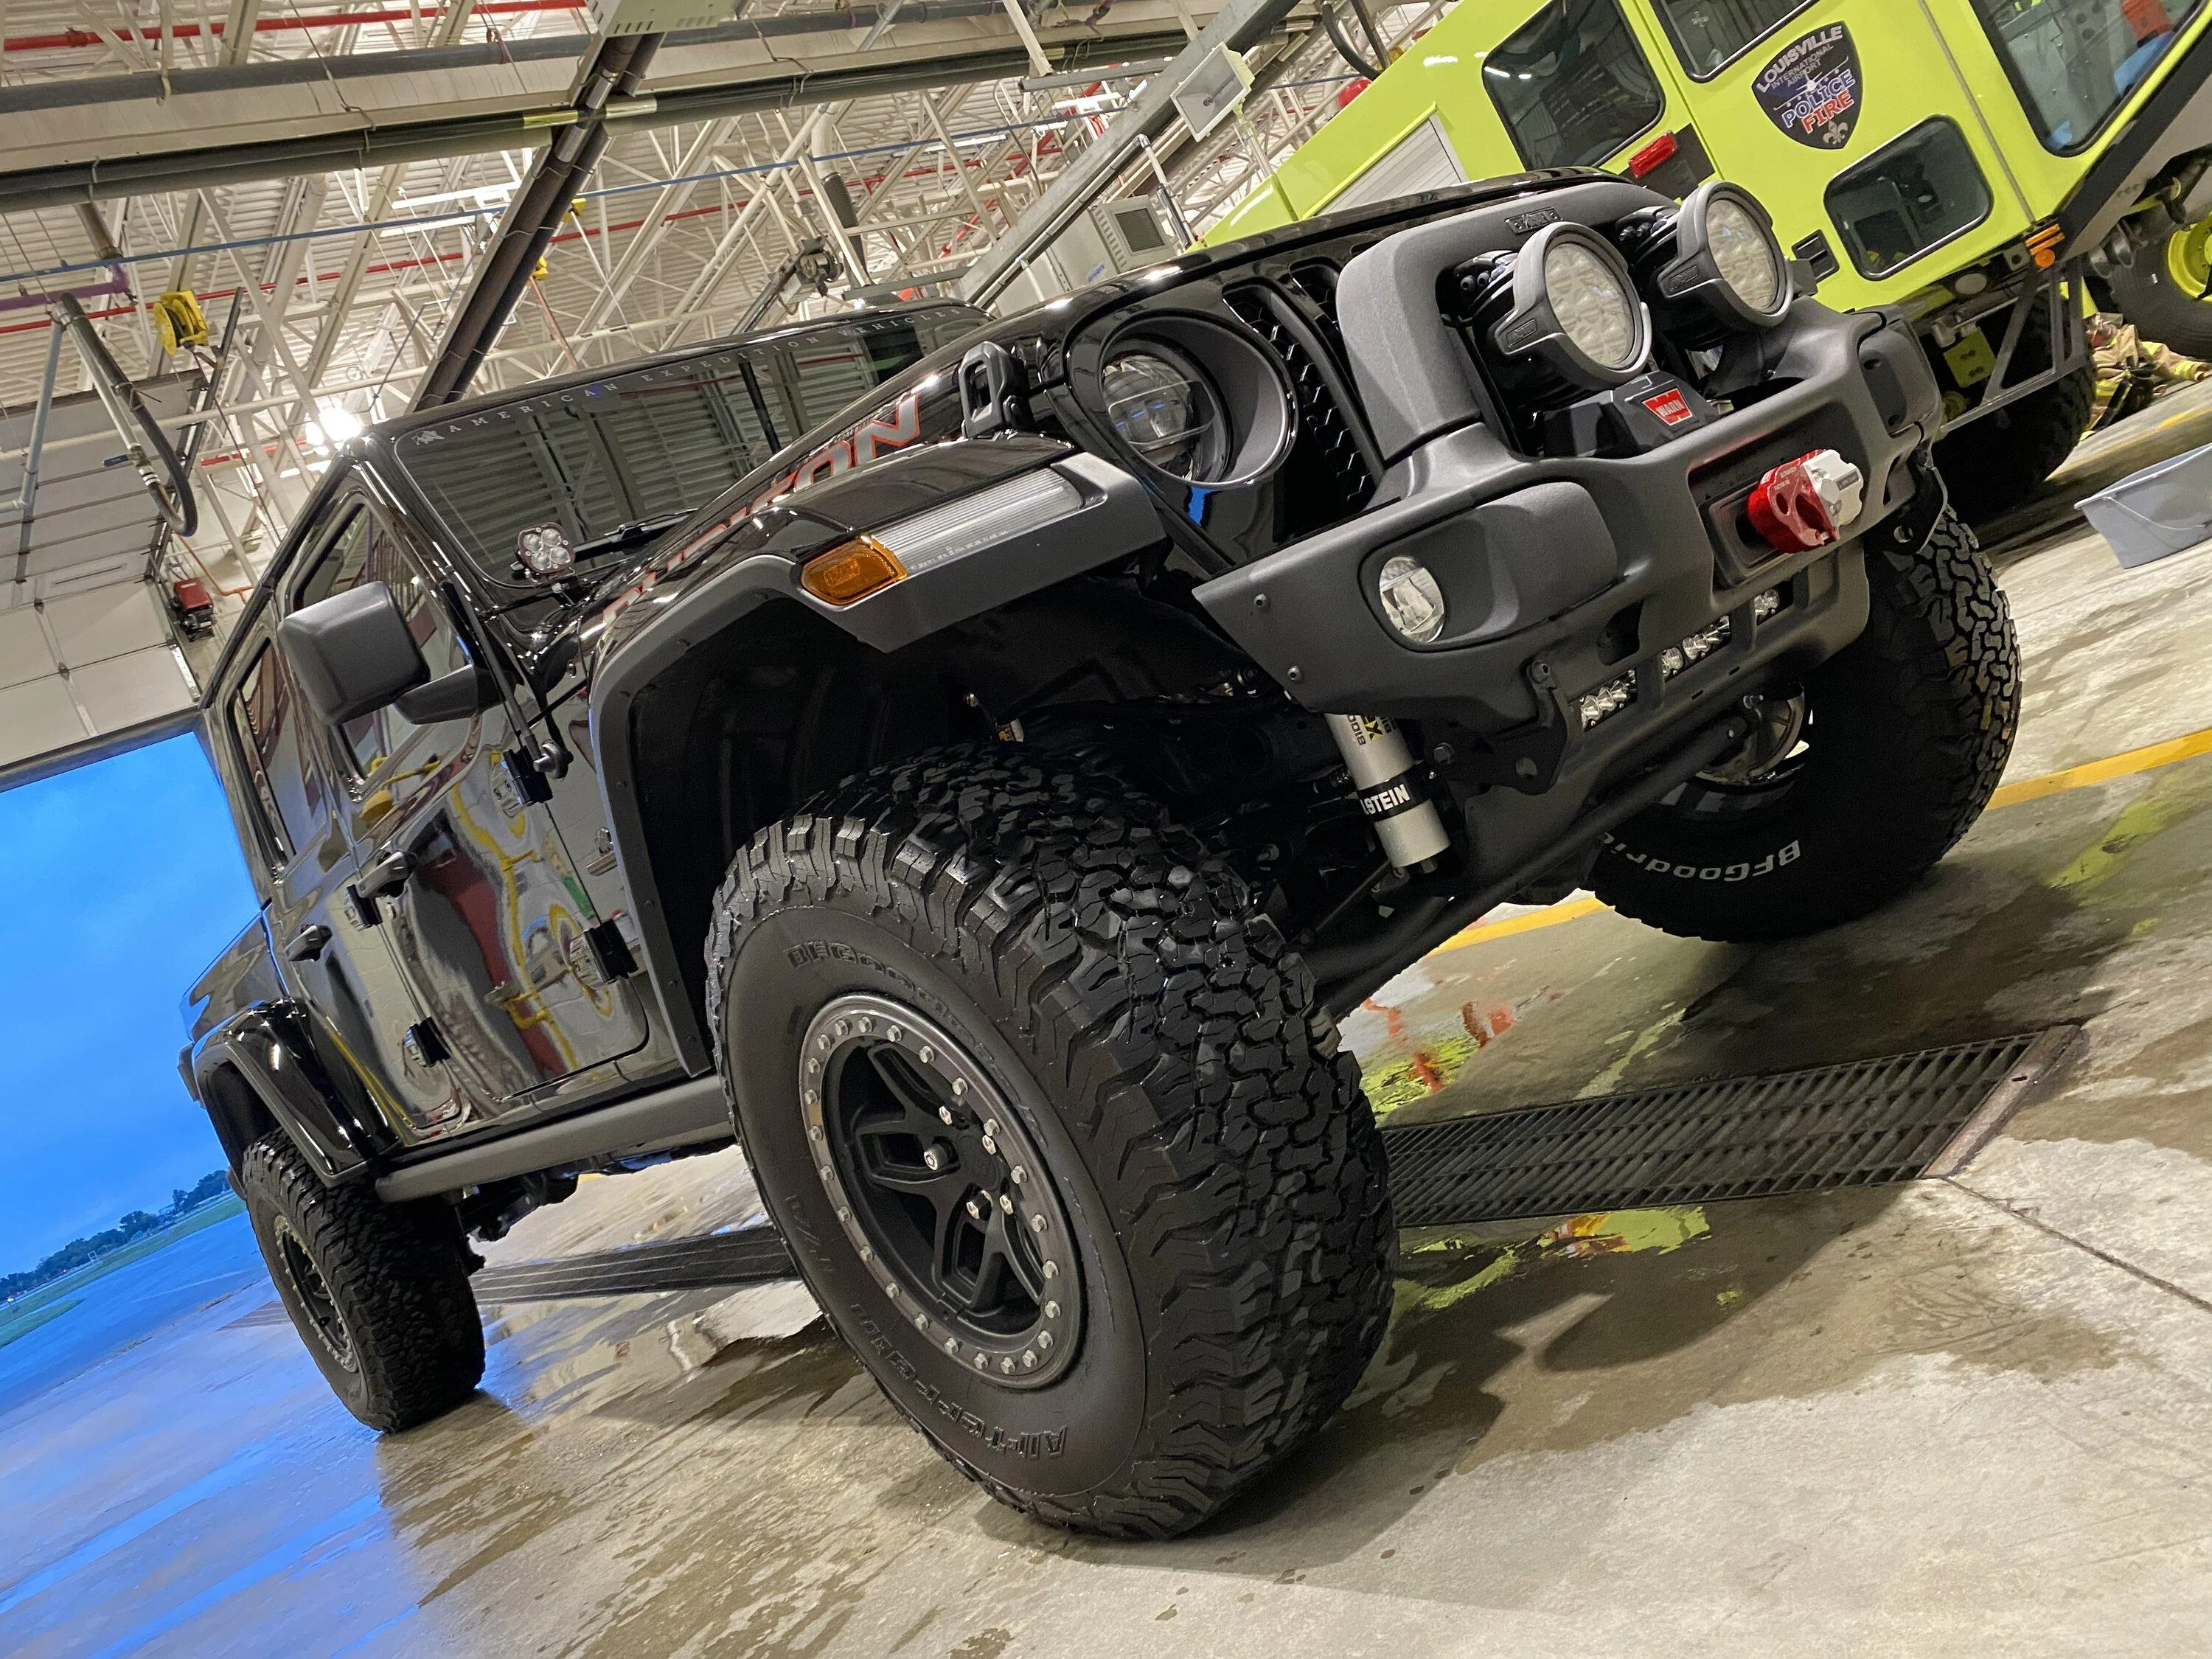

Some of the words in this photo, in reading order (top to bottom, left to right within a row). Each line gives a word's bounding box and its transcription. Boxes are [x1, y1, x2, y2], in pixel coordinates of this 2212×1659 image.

[1756, 26, 1843, 93] LOUISVILLE
[1772, 43, 1834, 88] INTERNATIONAL
[1787, 60, 1821, 87] AIRPORT
[1781, 69, 1856, 128] POLICE
[1801, 89, 1855, 133] FIRE
[448, 383, 619, 434] AMERICAN
[641, 335, 818, 382] EXPEDITION
[838, 308, 960, 337] VEHICLES
[1655, 399, 1686, 417] WARN
[1360, 784, 1411, 815] LSTEIN
